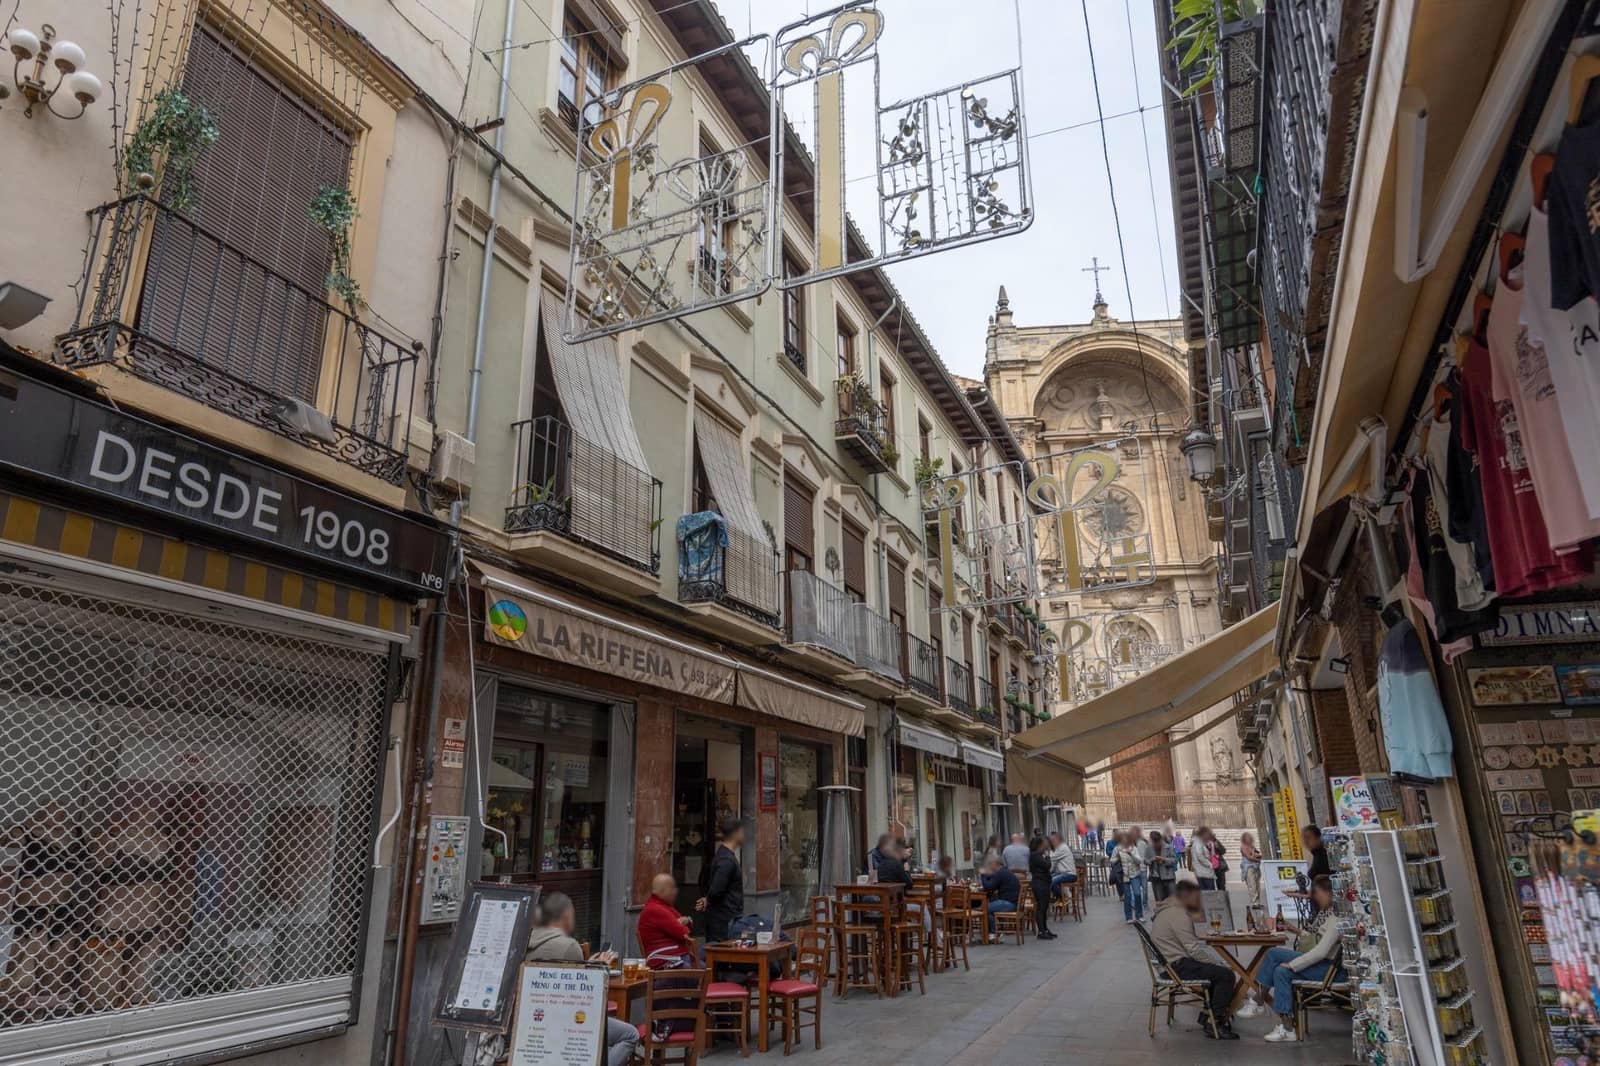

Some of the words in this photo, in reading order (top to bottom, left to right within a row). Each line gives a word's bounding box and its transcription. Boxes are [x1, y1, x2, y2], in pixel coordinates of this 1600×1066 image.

[89, 430, 282, 534] DESDE
[300, 505, 391, 566] 1908
[537, 618, 571, 651] LA
[580, 631, 674, 680] RIFFEÑA
